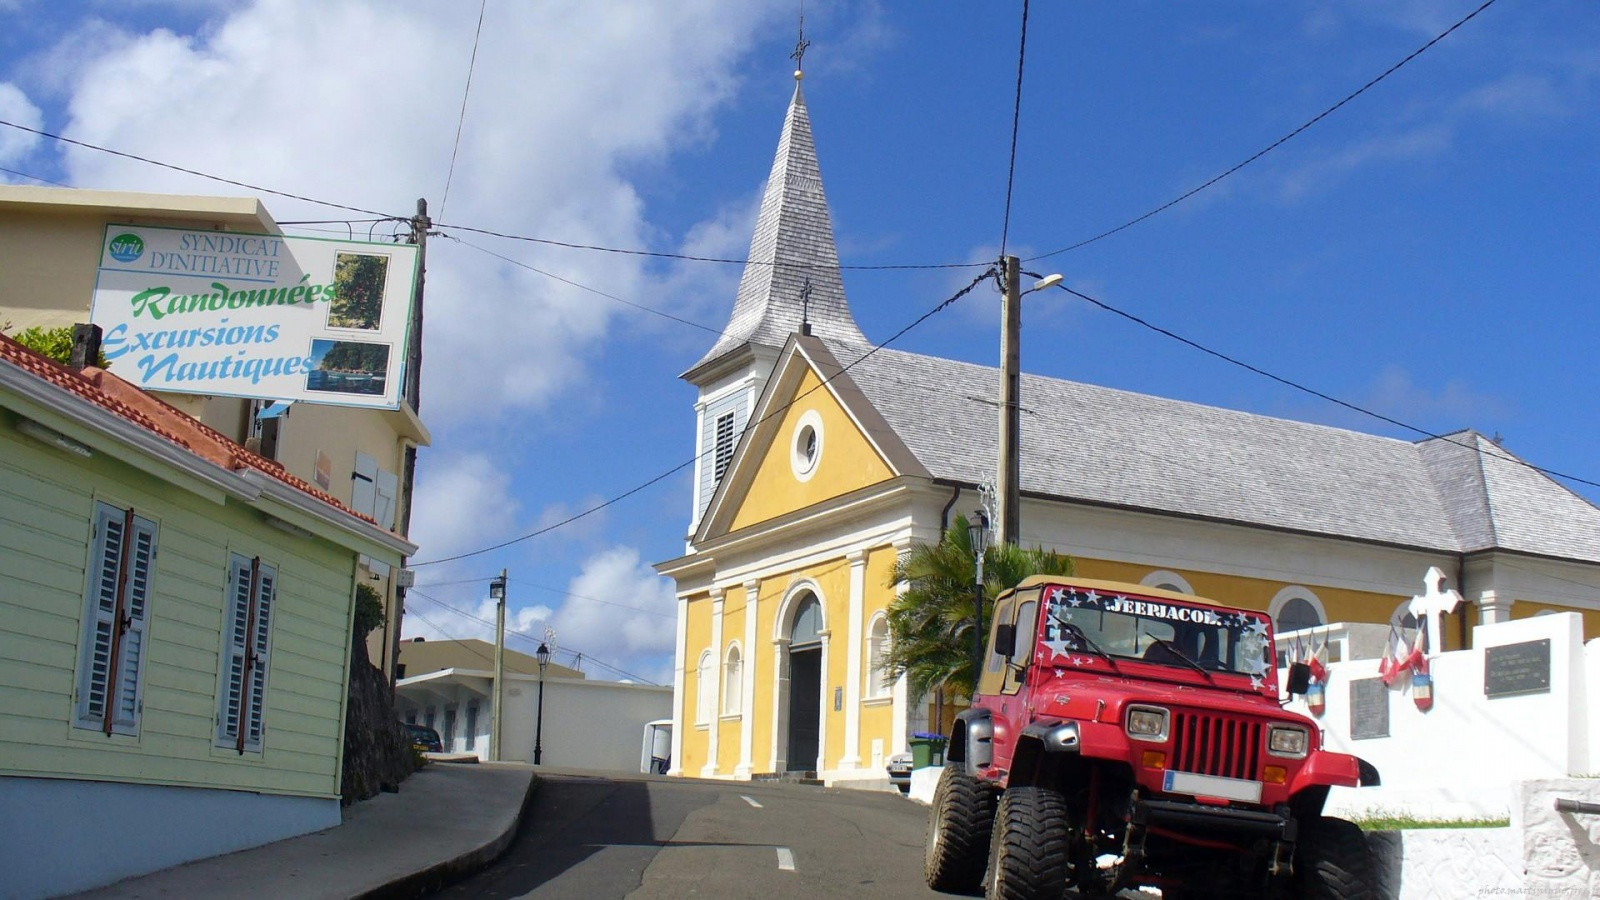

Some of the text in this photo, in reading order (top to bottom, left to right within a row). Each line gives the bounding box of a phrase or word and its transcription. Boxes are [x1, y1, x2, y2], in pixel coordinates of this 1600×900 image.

[180, 233, 283, 256] SYNDICAT
[150, 251, 279, 277] D'INITIATIVE
[131, 273, 338, 320] Randonnées
[102, 318, 280, 360] Excursions
[137, 350, 315, 385] Nautiques
